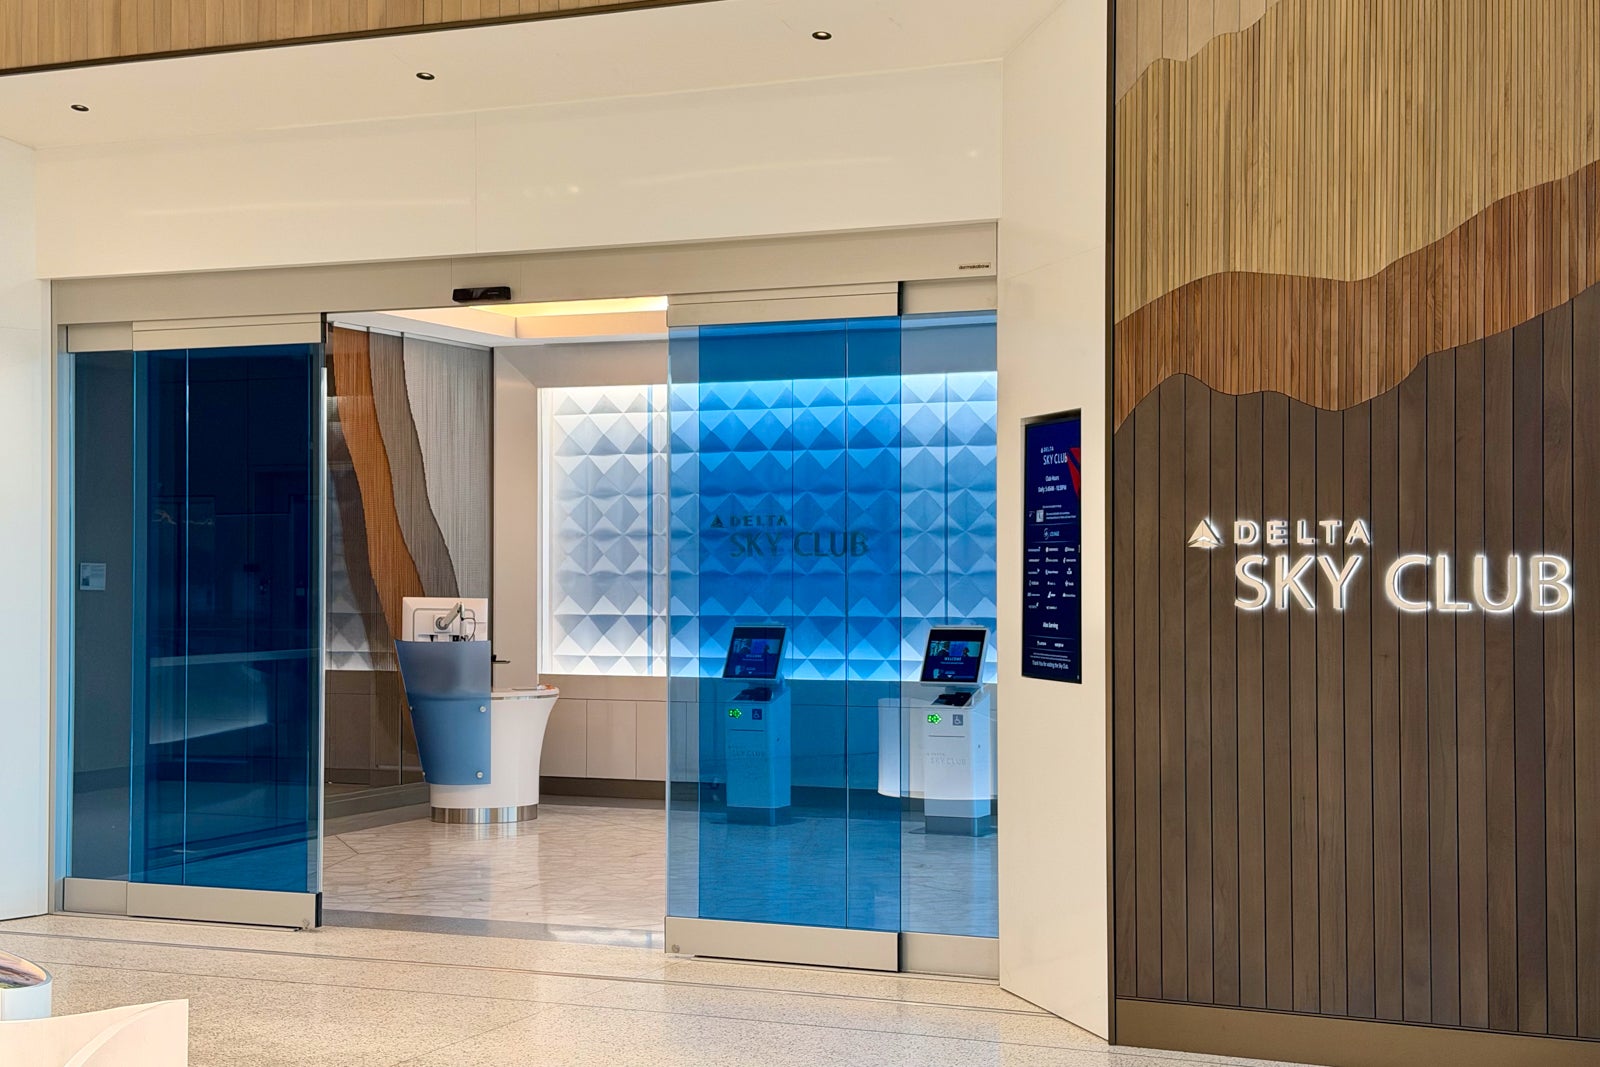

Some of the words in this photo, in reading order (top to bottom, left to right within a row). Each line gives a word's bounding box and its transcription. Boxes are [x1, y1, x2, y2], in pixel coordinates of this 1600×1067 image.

[1043, 454, 1053, 465] SKY
[1054, 452, 1068, 464] CLUB
[730, 515, 788, 527] DELTA
[1234, 520, 1371, 546] DELTA
[730, 531, 783, 558] SKY
[794, 531, 869, 558] CLUB
[1234, 554, 1362, 611] SKY
[1384, 553, 1573, 613] CLUB
